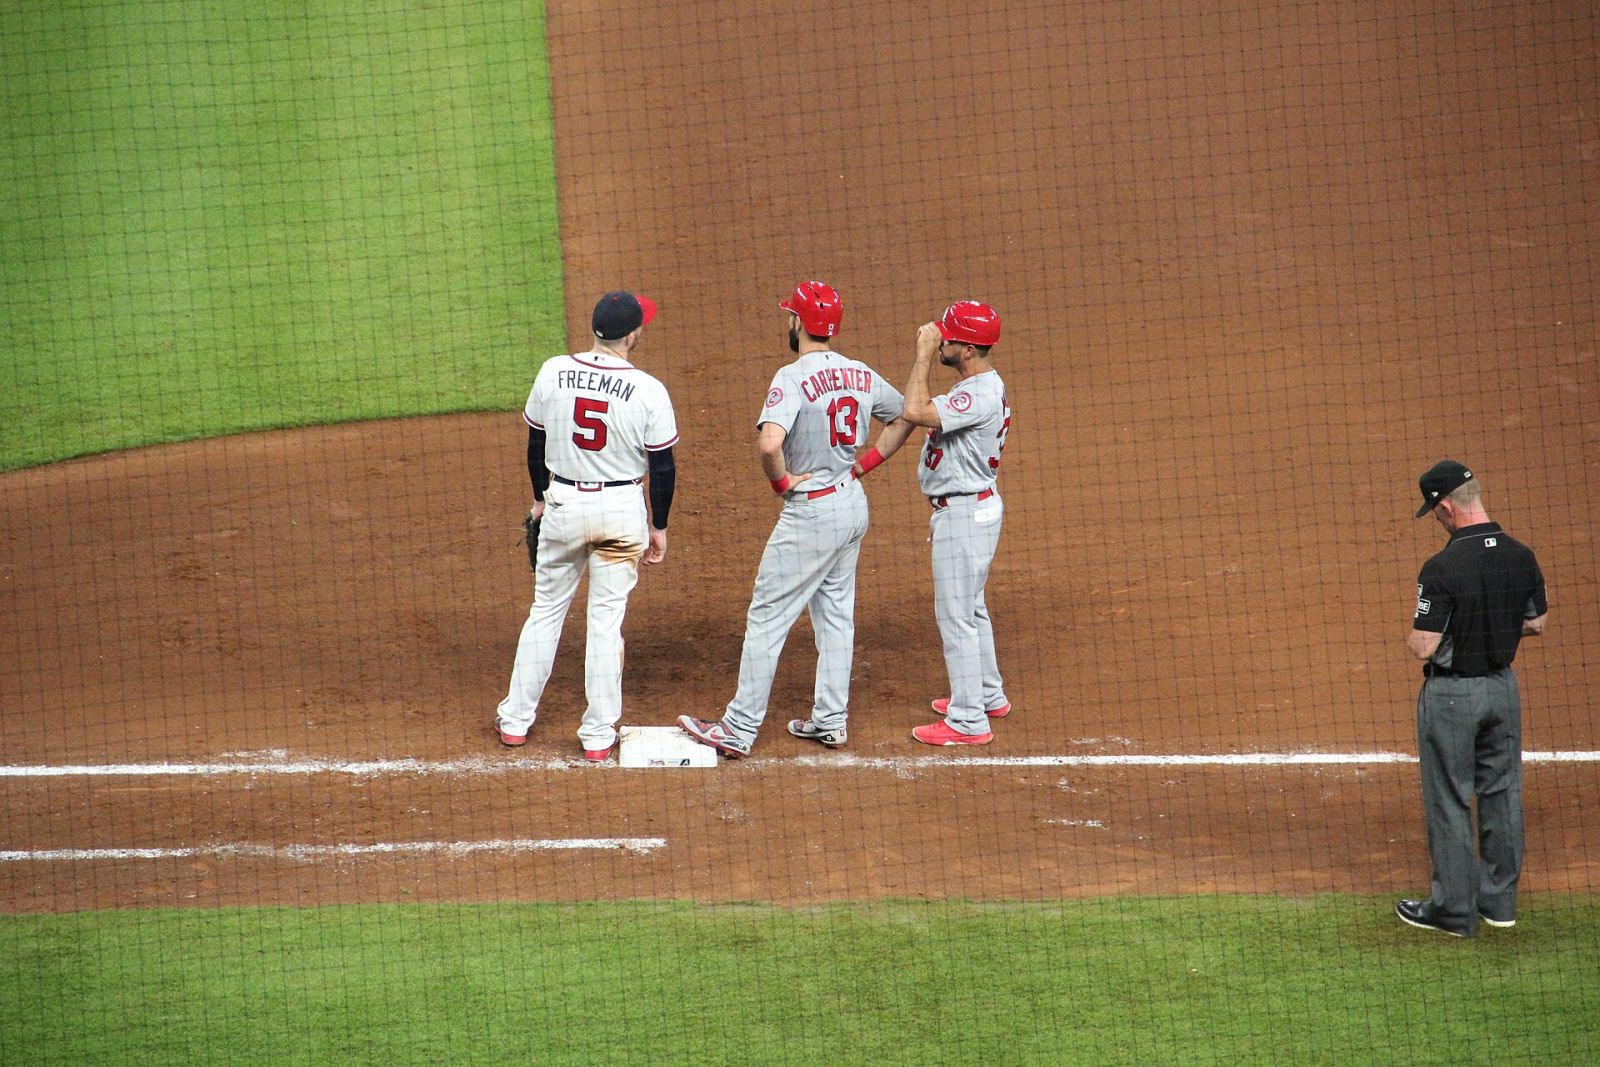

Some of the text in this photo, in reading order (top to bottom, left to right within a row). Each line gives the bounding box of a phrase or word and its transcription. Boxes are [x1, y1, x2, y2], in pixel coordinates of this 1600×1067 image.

[558, 370, 636, 402] FREEMAN
[801, 367, 872, 402] CARPENTER
[572, 396, 609, 451] 5
[826, 396, 858, 447] 13
[924, 444, 943, 471] 37
